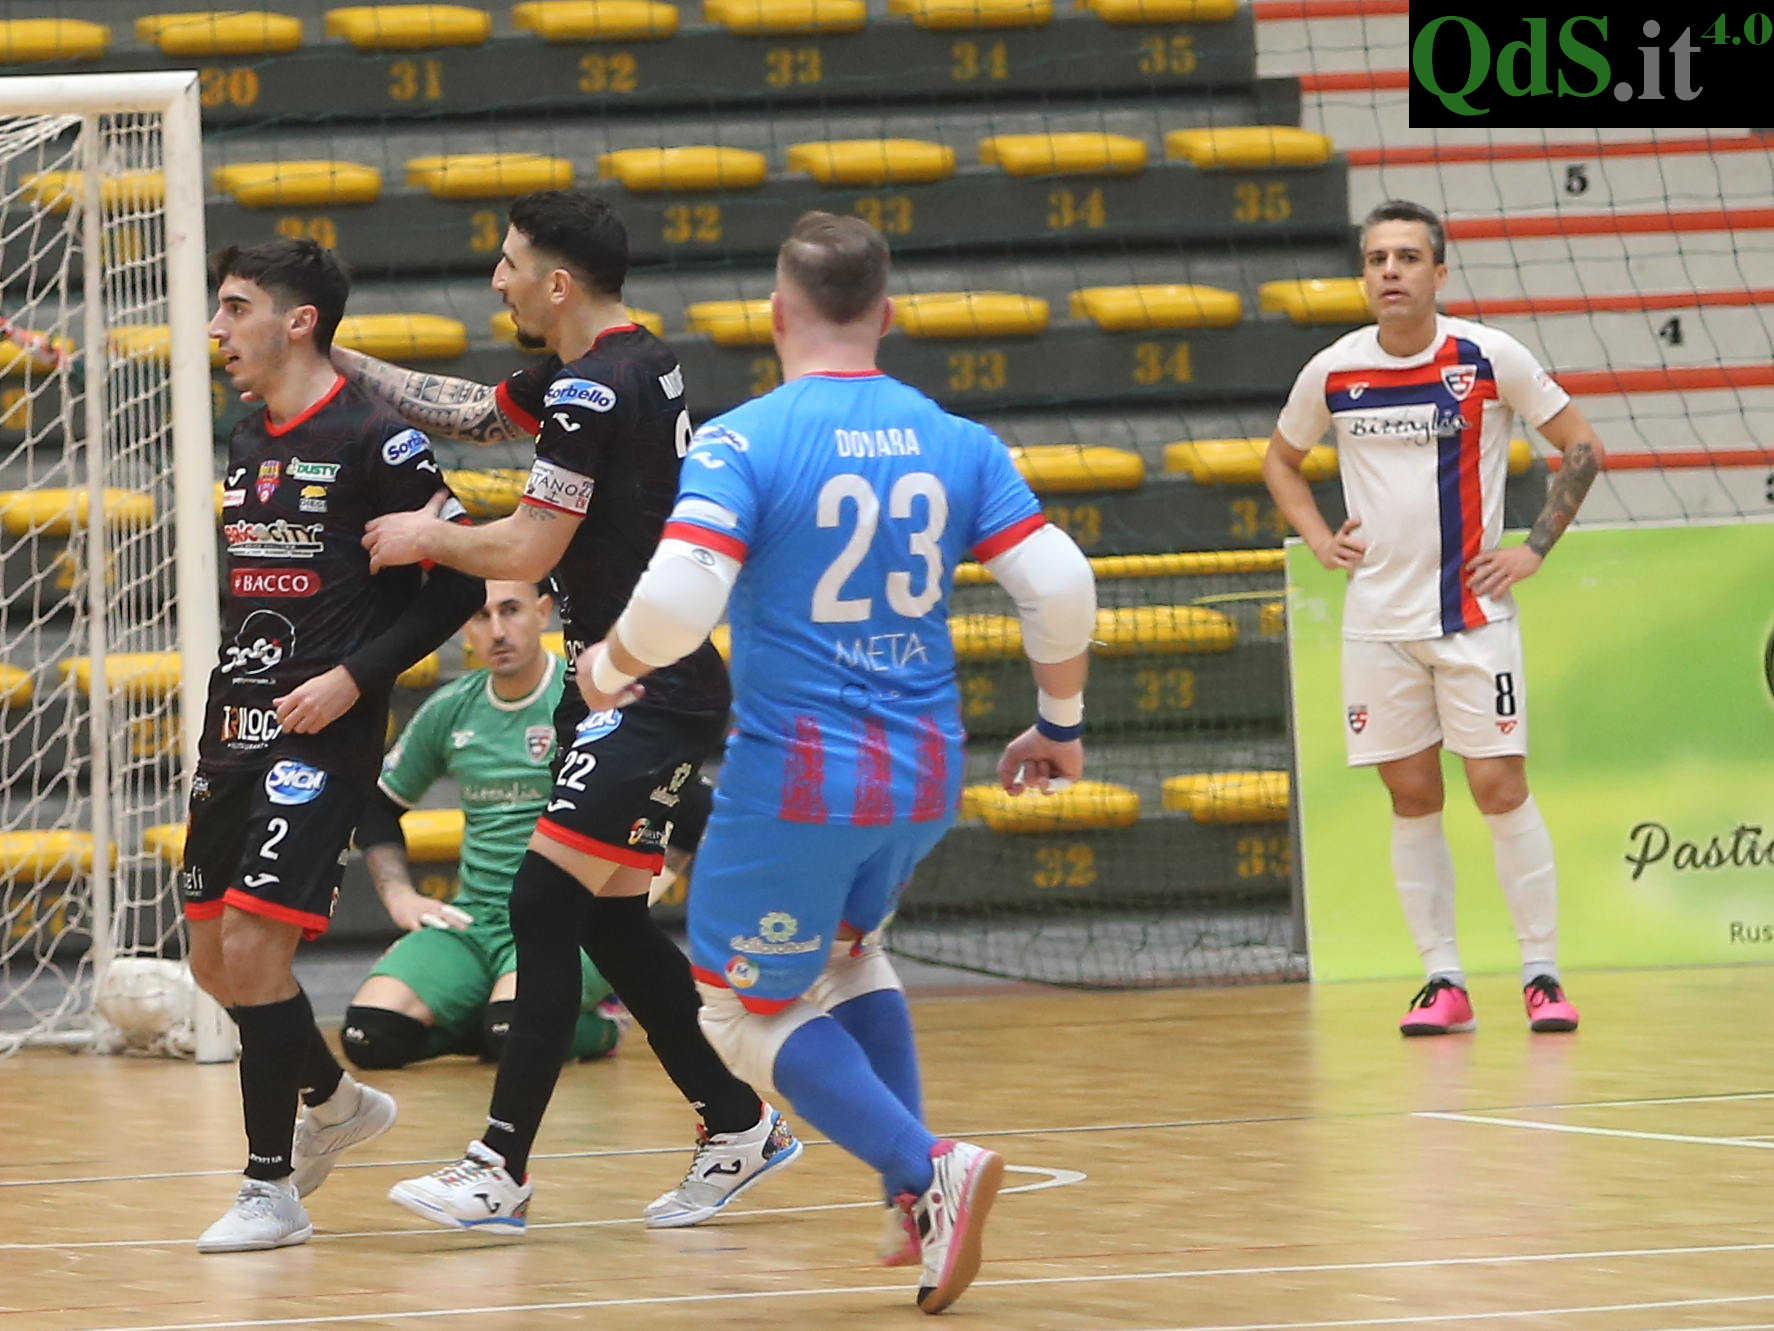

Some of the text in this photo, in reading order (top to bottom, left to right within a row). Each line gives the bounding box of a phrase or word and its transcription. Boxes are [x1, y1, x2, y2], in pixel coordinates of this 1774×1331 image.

[579, 53, 638, 92] 32
[766, 48, 822, 86] 33
[952, 42, 1008, 80] 34
[1139, 35, 1197, 75] 35
[200, 68, 259, 107] 30
[388, 60, 442, 99] 31
[1564, 165, 1588, 195] 5
[1047, 188, 1106, 228] 34
[1234, 182, 1291, 222] 35
[469, 211, 500, 251] 3
[661, 205, 723, 244] 32
[1659, 315, 1683, 346] 4
[948, 353, 1007, 391] 33
[1133, 343, 1193, 384] 34
[297, 464, 337, 476] DUSTY
[811, 471, 949, 623] 23
[242, 575, 309, 592] BACCO
[834, 632, 929, 671] META
[1135, 669, 1195, 711] 33
[1495, 672, 1516, 716] 8
[555, 750, 597, 792] 22
[259, 817, 290, 861] 2
[1033, 845, 1097, 888] 32
